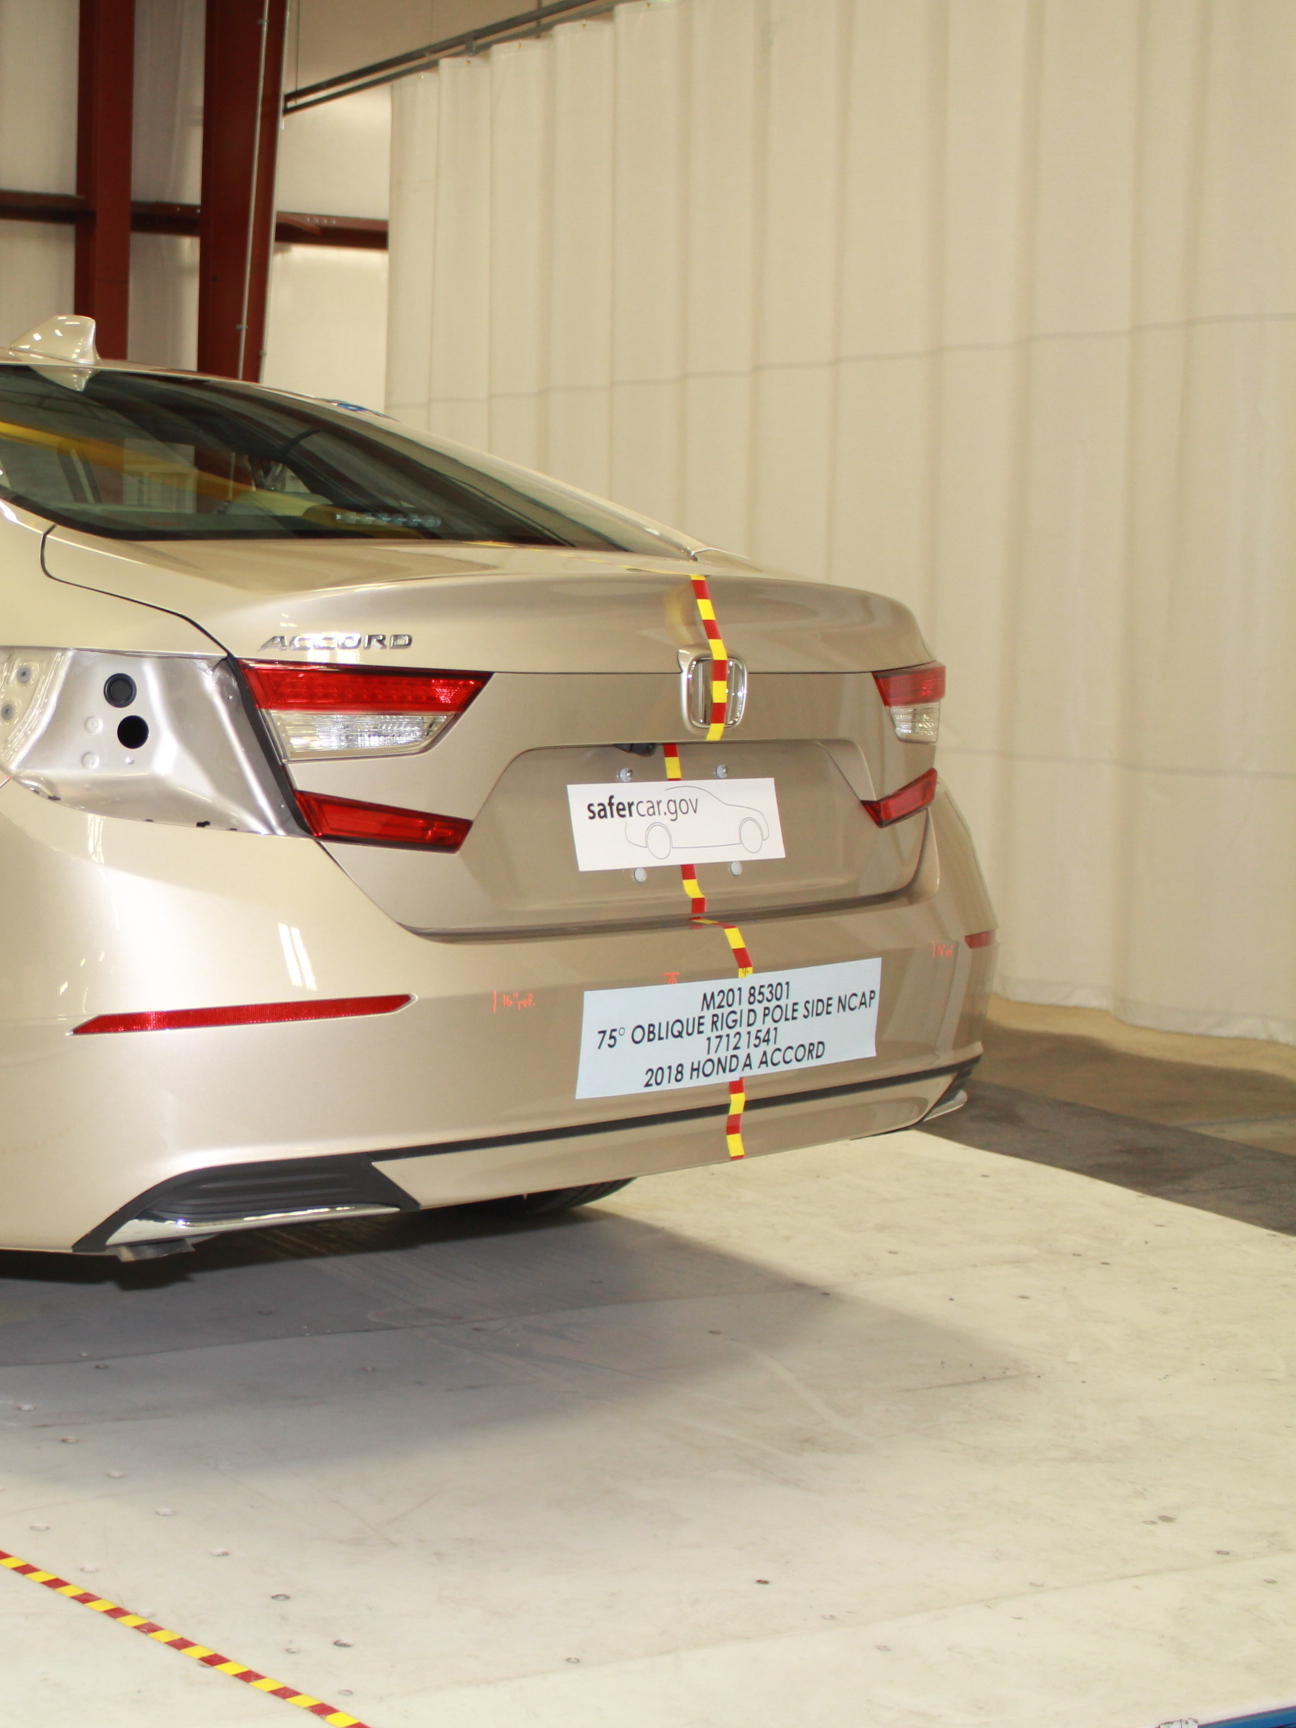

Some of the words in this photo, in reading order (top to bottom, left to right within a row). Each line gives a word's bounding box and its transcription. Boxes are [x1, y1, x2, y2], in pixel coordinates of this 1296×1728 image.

[257, 634, 413, 652] ACCORD
[586, 794, 699, 822] safercar.gov
[700, 981, 791, 1012] M20185301
[597, 1026, 626, 1050] 75°
[630, 1014, 706, 1046] OBLIQUE
[710, 1009, 758, 1033] RIGID
[762, 1002, 799, 1026] POLE
[802, 996, 833, 1020] SIDE
[836, 989, 877, 1014] NCAP
[706, 1026, 779, 1056] 17121541
[643, 1062, 685, 1088] 2018
[689, 1053, 753, 1081] HONDA
[758, 1040, 826, 1070] ACCORD
